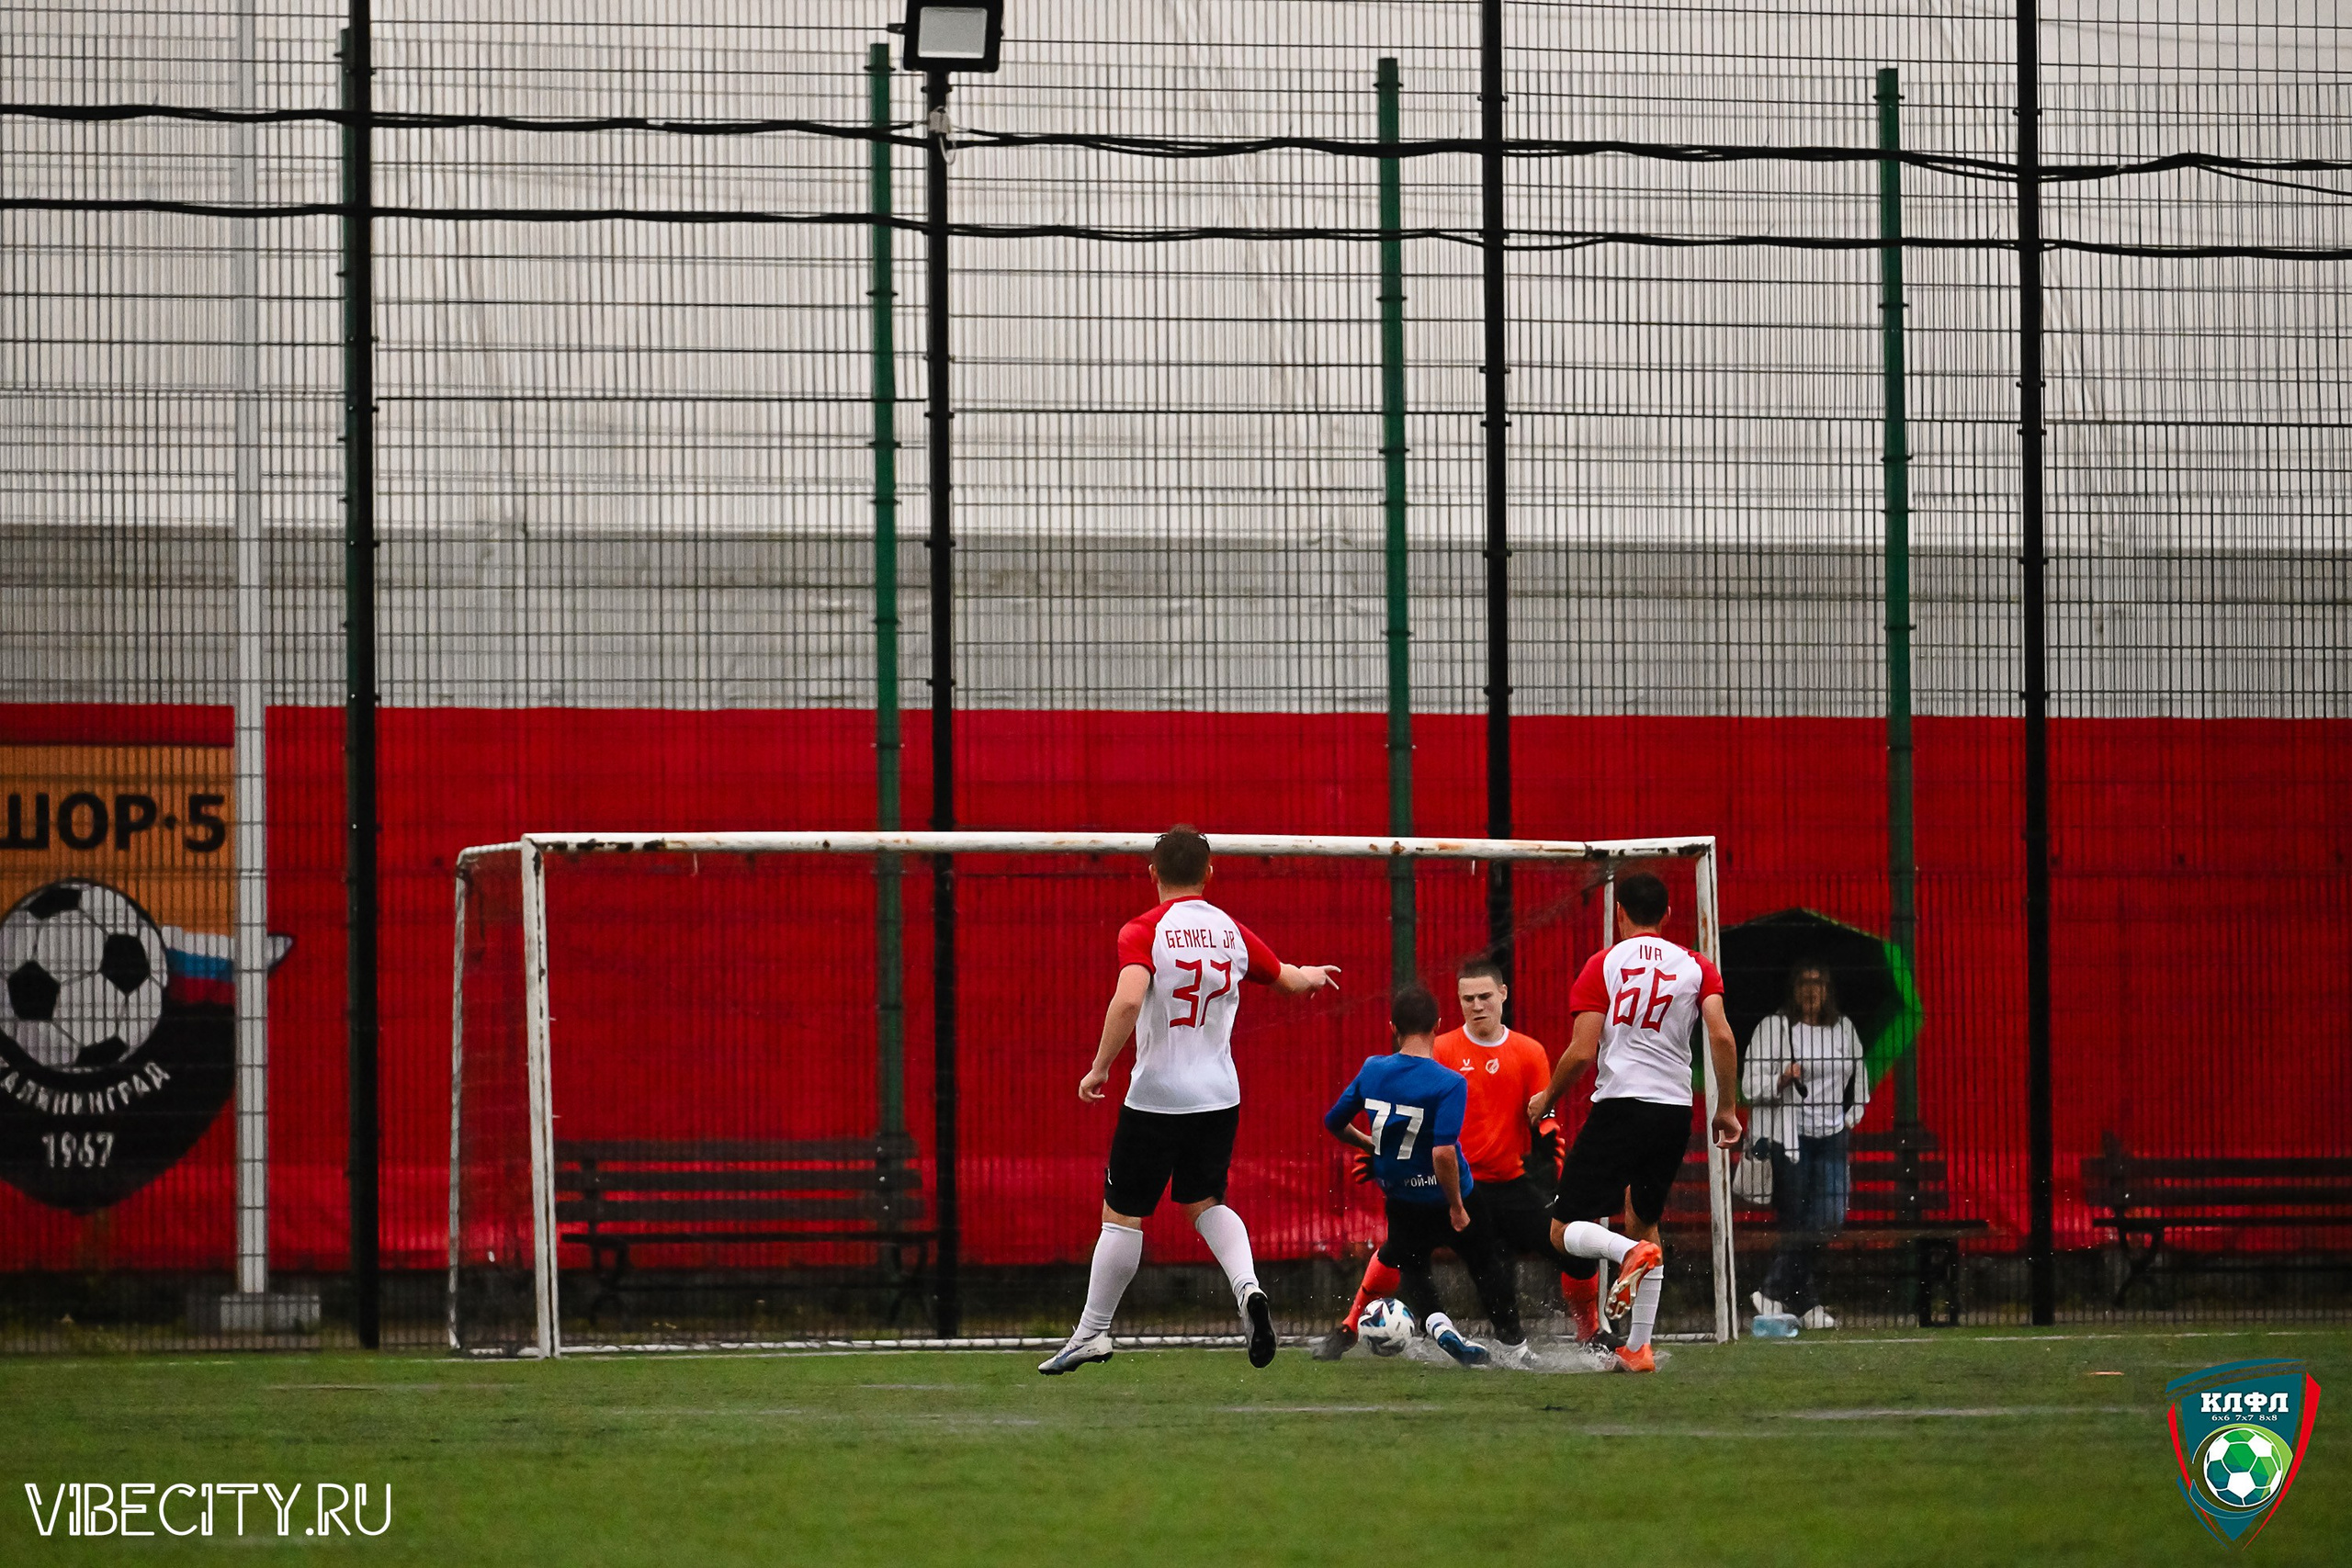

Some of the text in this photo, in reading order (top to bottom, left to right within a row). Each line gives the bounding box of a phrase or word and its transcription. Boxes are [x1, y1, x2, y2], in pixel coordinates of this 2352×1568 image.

[1165, 929, 1236, 950] GENKEL JR
[1639, 944, 1663, 962] IVA
[1169, 958, 1232, 1029] 37
[1612, 966, 1677, 1033] 66
[41, 1131, 115, 1168] 1967
[1364, 1098, 1425, 1160] 77
